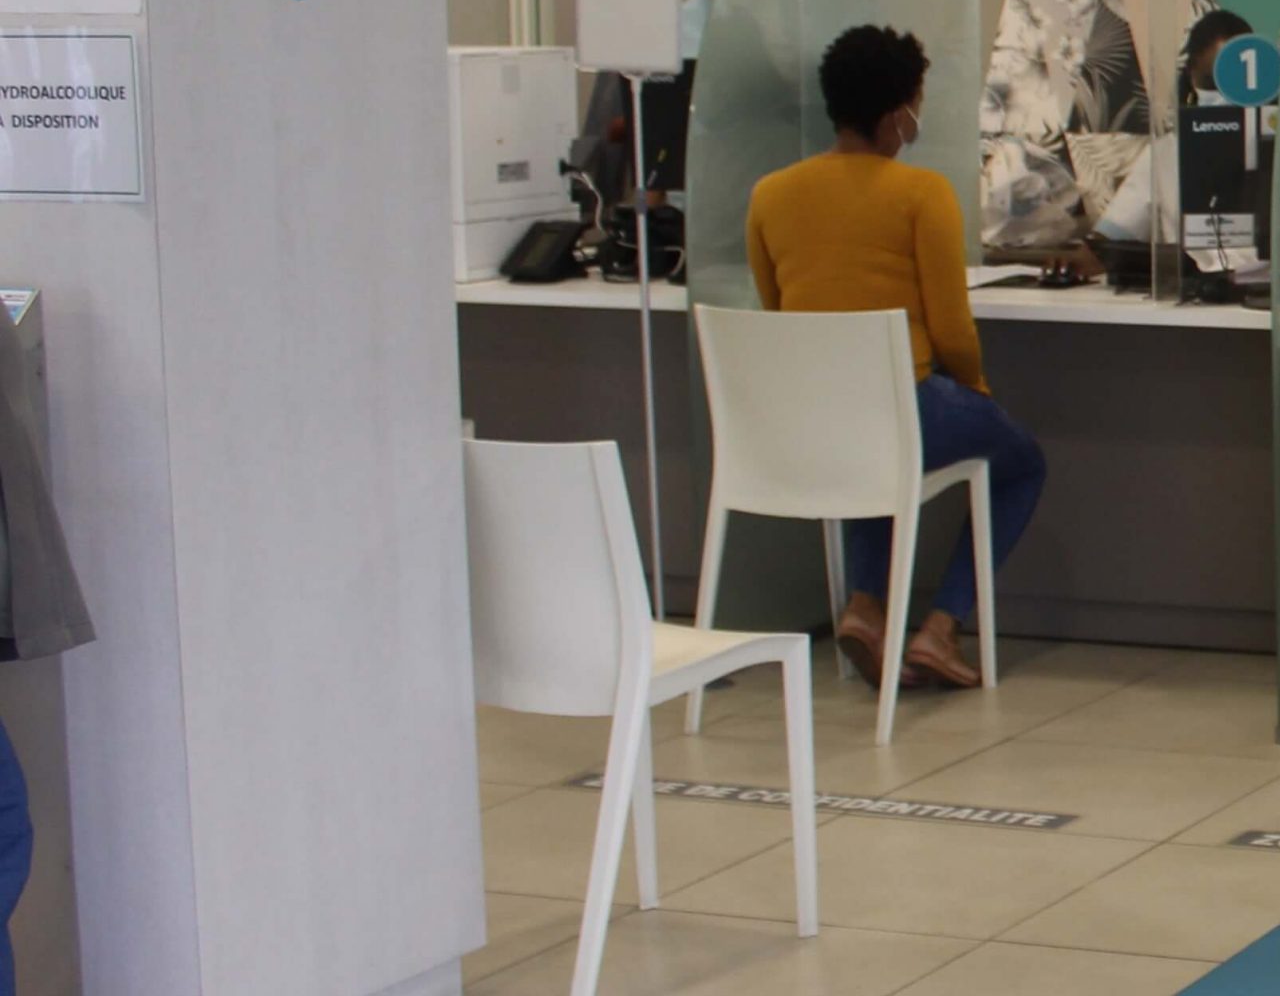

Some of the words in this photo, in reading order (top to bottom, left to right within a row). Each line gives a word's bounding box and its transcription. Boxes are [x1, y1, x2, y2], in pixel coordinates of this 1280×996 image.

[1239, 48, 1258, 90] 1
[0, 85, 127, 101] YDROALCOOLIQUE
[11, 114, 99, 129] DISPOSITION
[1192, 120, 1240, 133] Lenovo
[684, 784, 739, 799] DE
[737, 789, 1057, 827] COFIDENTIALITE
